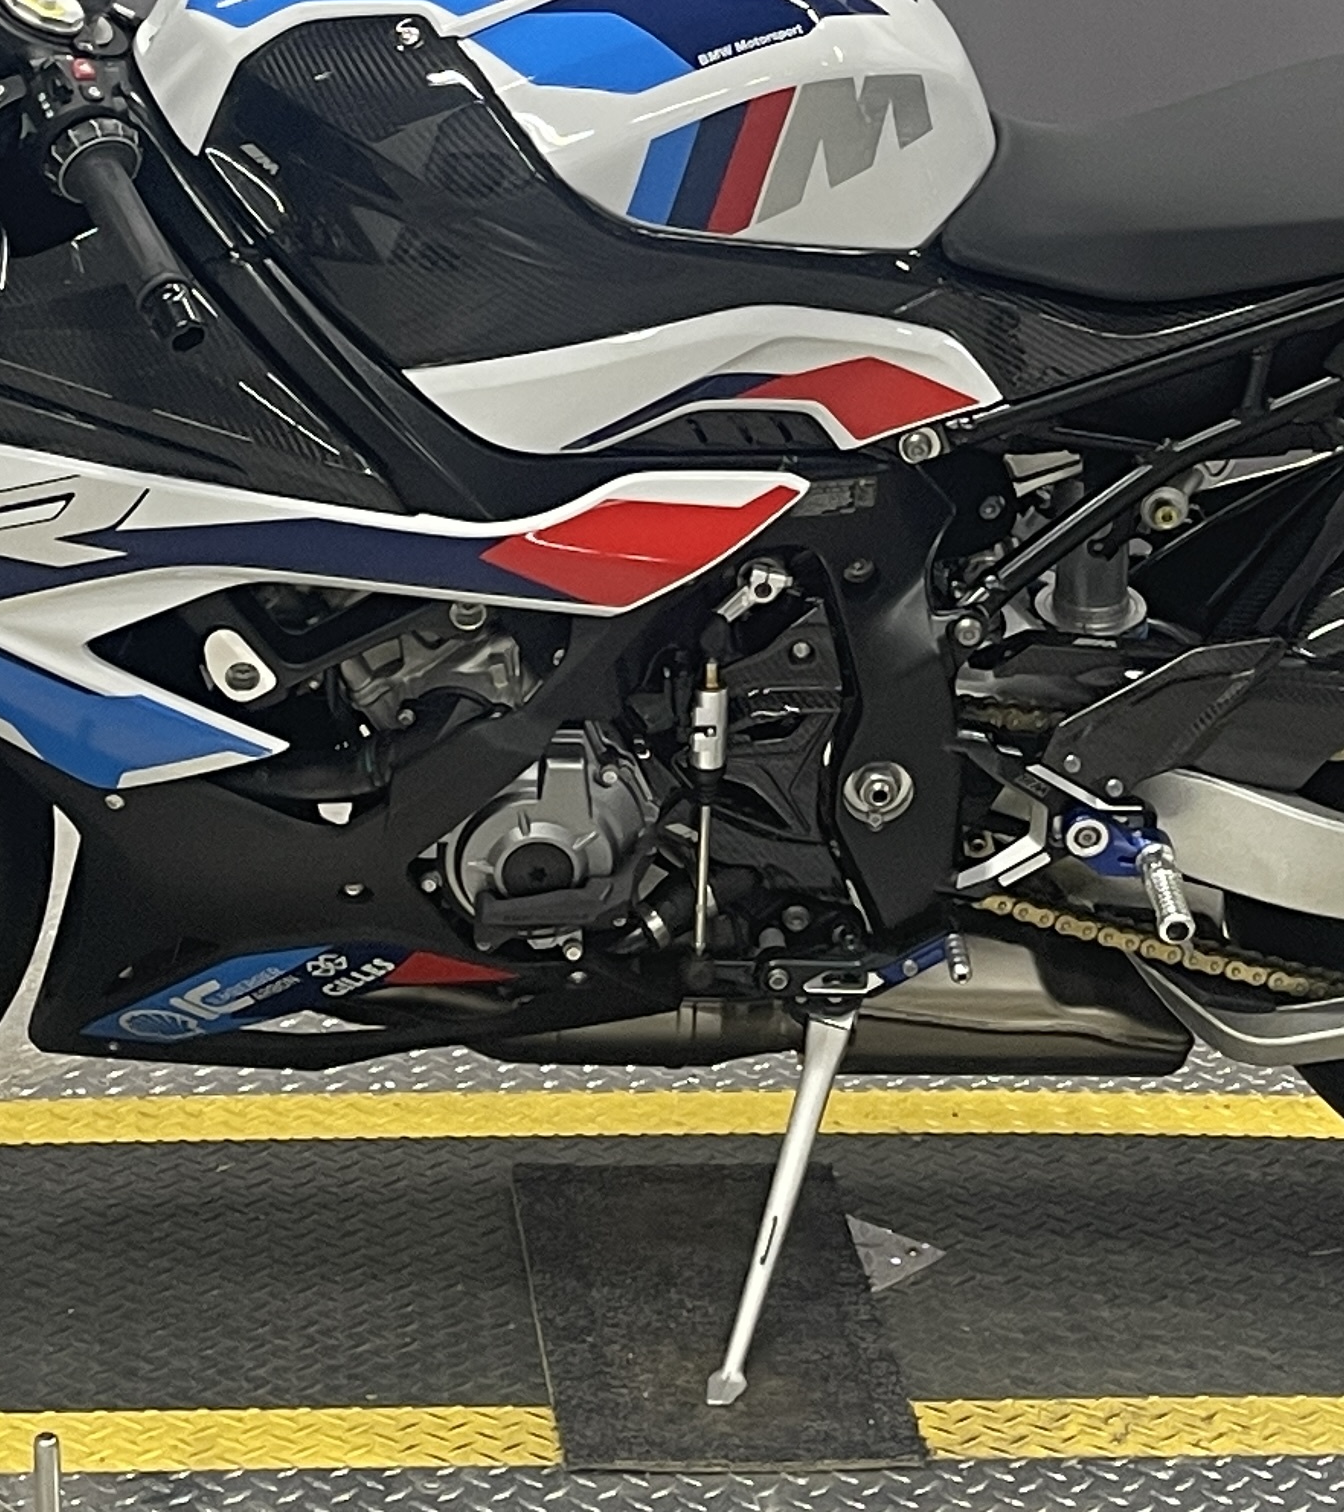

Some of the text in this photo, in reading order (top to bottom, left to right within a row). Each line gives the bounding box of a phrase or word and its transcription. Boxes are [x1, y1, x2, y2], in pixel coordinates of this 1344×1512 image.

[697, 23, 804, 67] BMW Motorsport
[321, 956, 396, 997] GILLES
